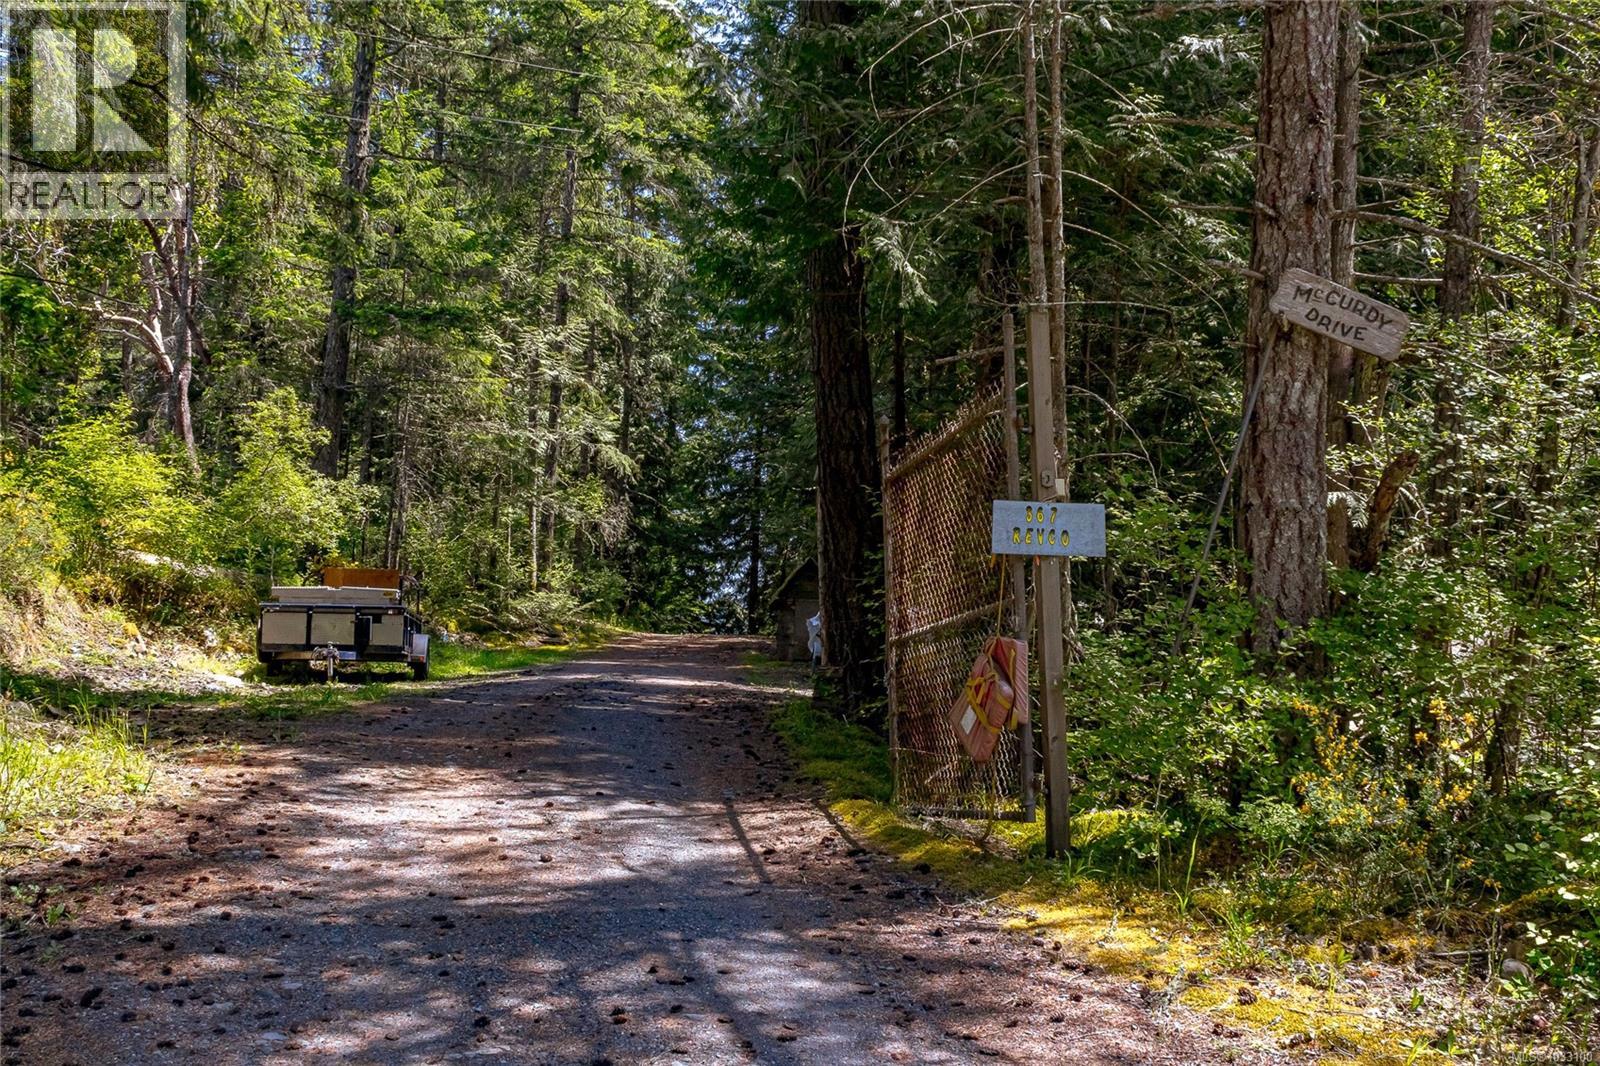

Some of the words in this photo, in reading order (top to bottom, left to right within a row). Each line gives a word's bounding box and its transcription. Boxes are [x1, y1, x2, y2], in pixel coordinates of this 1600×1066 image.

[1292, 285, 1393, 330] McCURDY
[1304, 307, 1368, 341] DRIVE
[1012, 527, 1070, 547] REVCO
